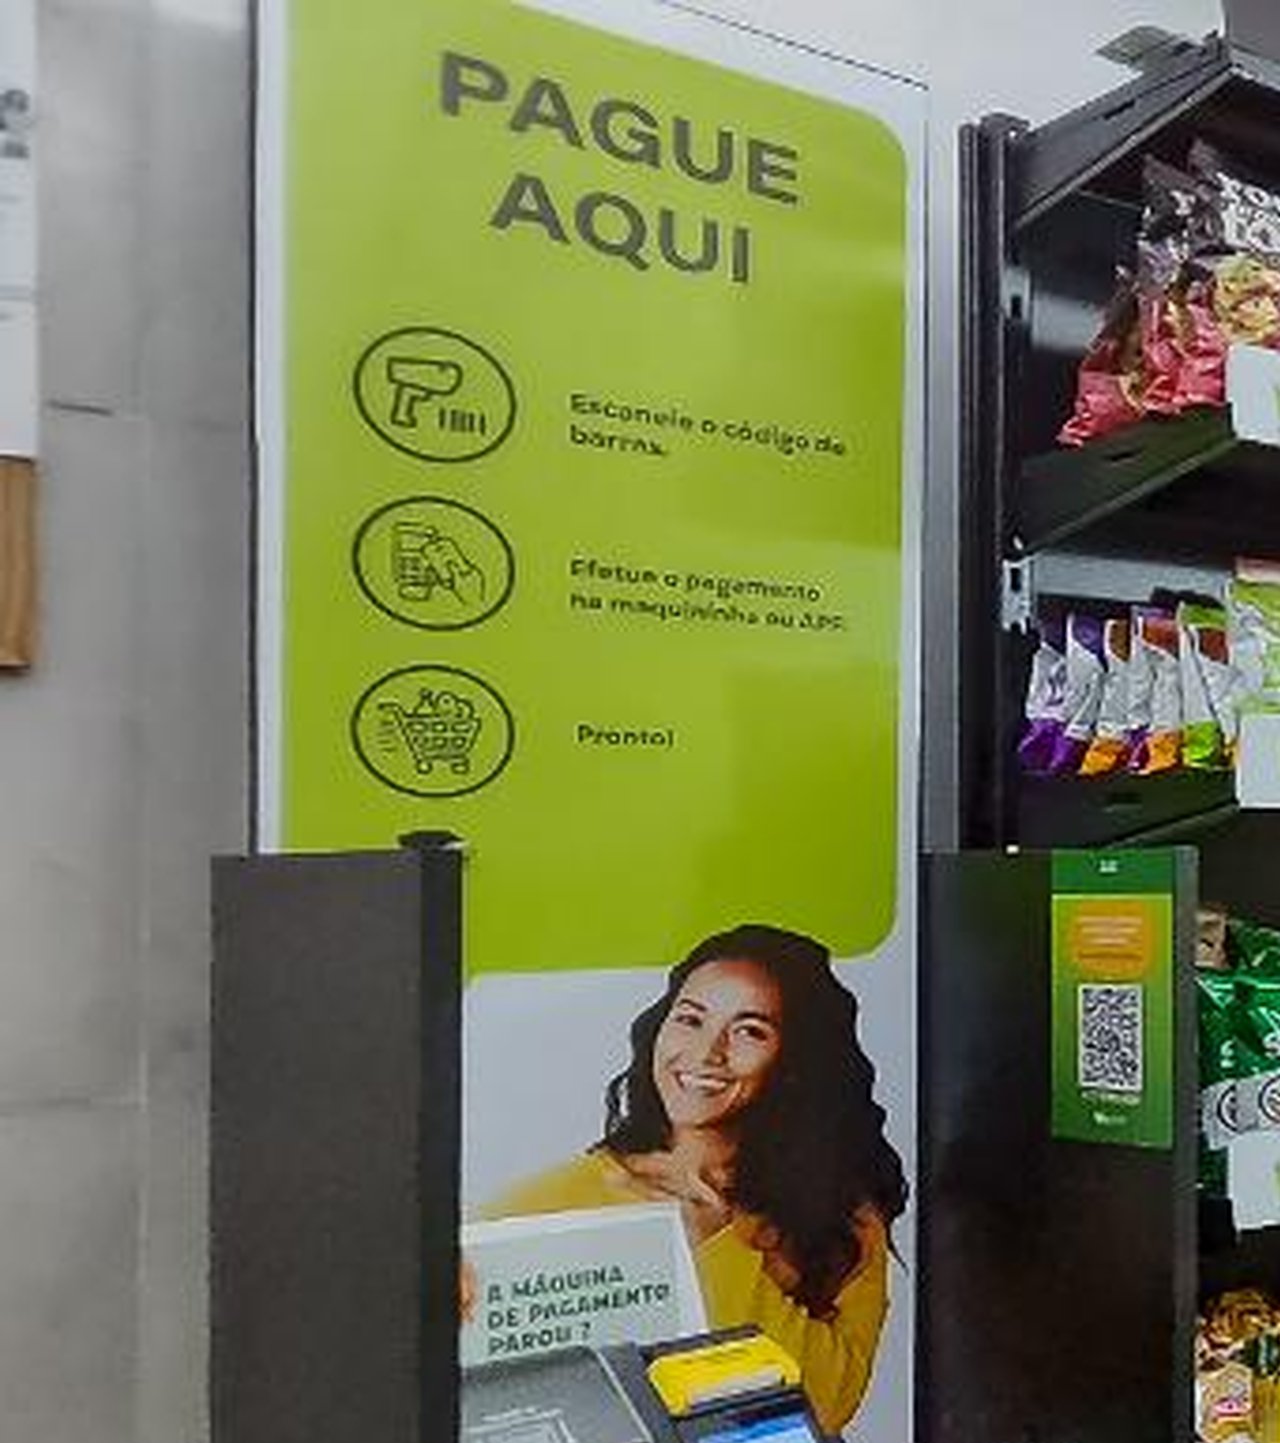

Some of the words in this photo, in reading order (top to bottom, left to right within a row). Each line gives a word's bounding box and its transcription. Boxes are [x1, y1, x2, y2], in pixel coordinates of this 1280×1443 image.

[438, 51, 800, 205] PAGUE
[489, 171, 752, 284] AQUI
[814, 435, 847, 456] de
[576, 729, 676, 750] Pronto!
[513, 1264, 625, 1298] MÁQUINA
[488, 1307, 520, 1330] DE
[529, 1283, 670, 1323] PAGAMENTO
[488, 1326, 571, 1356] PAROU
